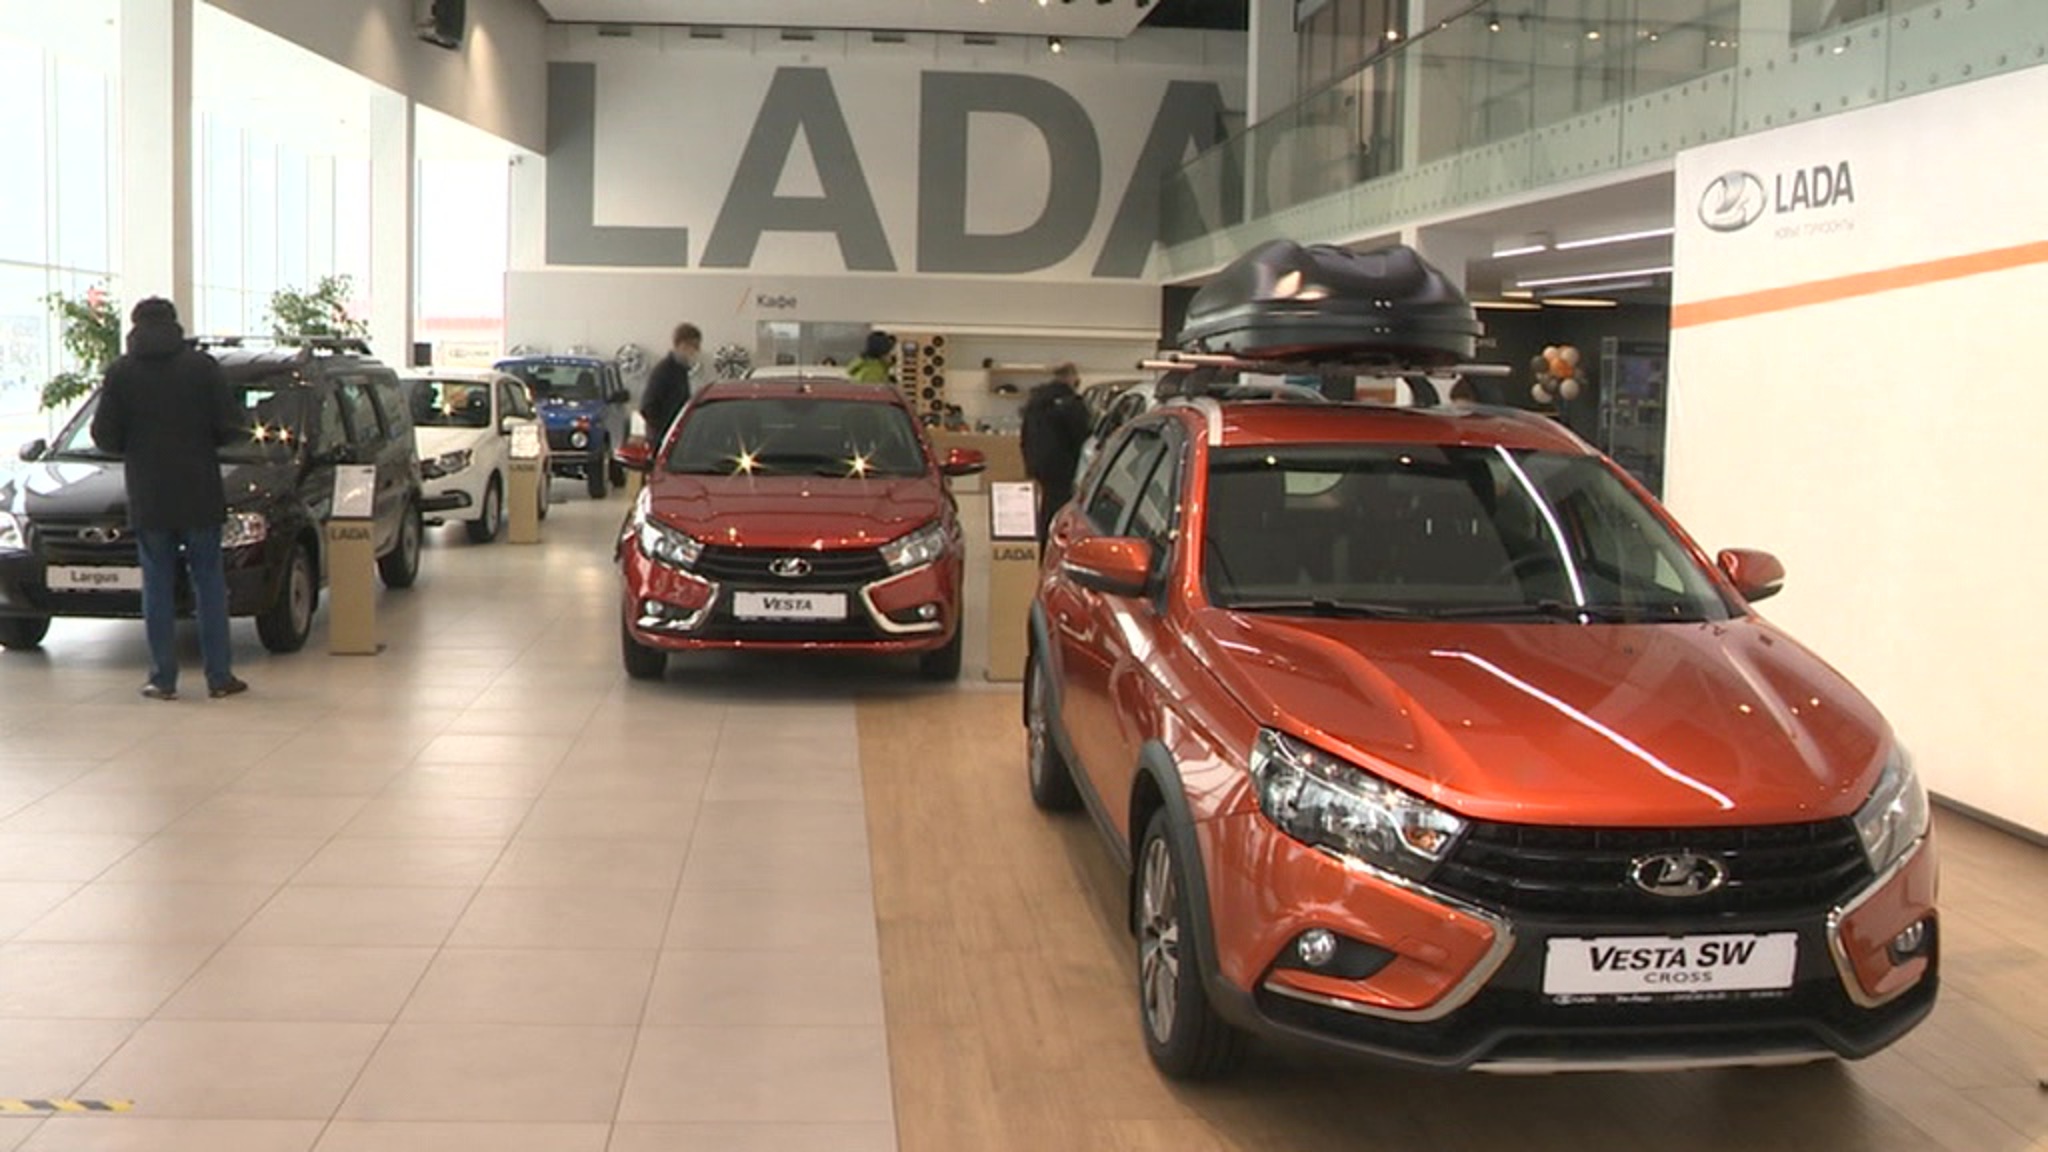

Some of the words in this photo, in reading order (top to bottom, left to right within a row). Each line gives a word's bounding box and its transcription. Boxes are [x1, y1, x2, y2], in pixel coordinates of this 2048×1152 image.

[546, 61, 1245, 279] LADA
[1775, 160, 1855, 214] LADA
[756, 294, 797, 309] Кафе
[331, 527, 371, 541] LADA
[993, 548, 1035, 561] LADA
[70, 570, 119, 585] Largus
[763, 597, 813, 611] VESTA
[1589, 946, 1688, 971] VESTA
[1696, 940, 1756, 967] SW
[1643, 971, 1713, 984] CROSS
